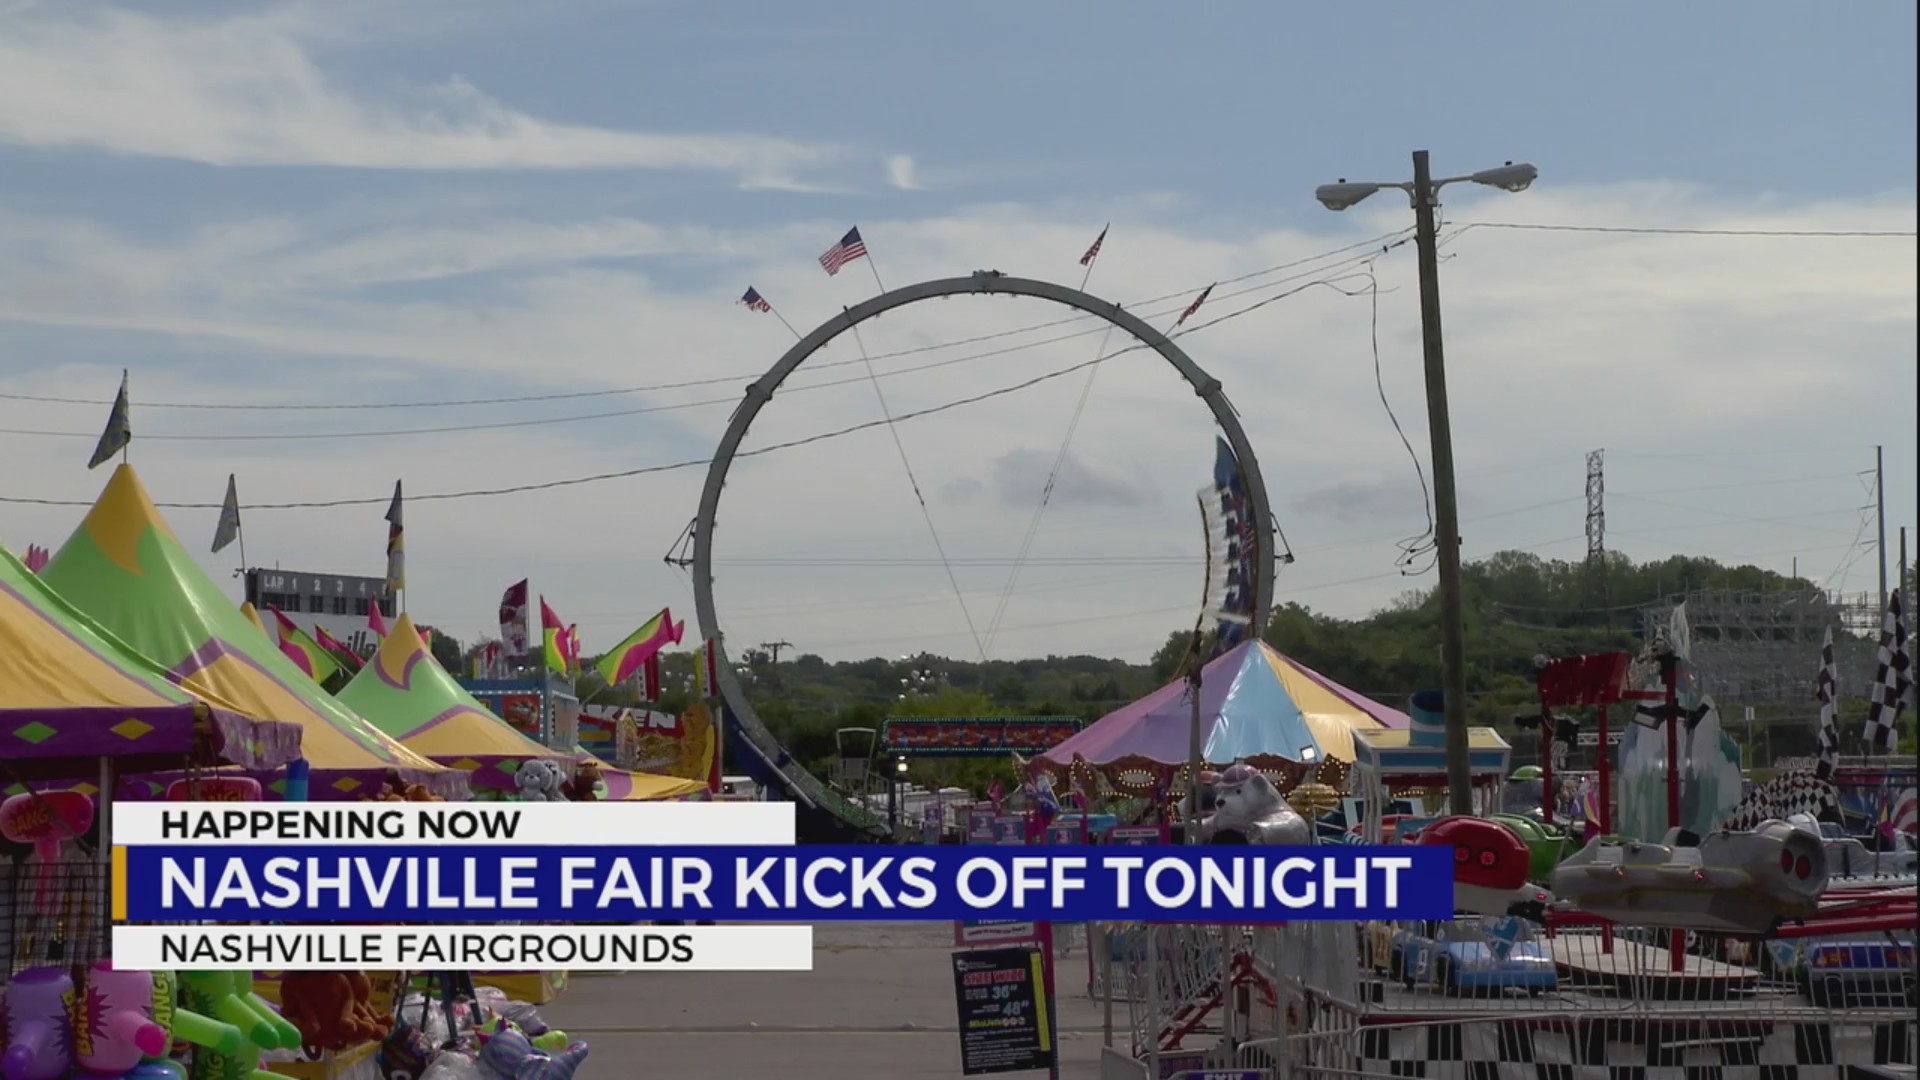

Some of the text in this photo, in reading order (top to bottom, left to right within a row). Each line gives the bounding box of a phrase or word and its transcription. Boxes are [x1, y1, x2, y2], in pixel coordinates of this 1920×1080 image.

[264, 576, 284, 589] LAP
[292, 578, 297, 590] 1
[314, 580, 321, 591] 2
[337, 581, 343, 593] 3
[360, 582, 366, 594] 4
